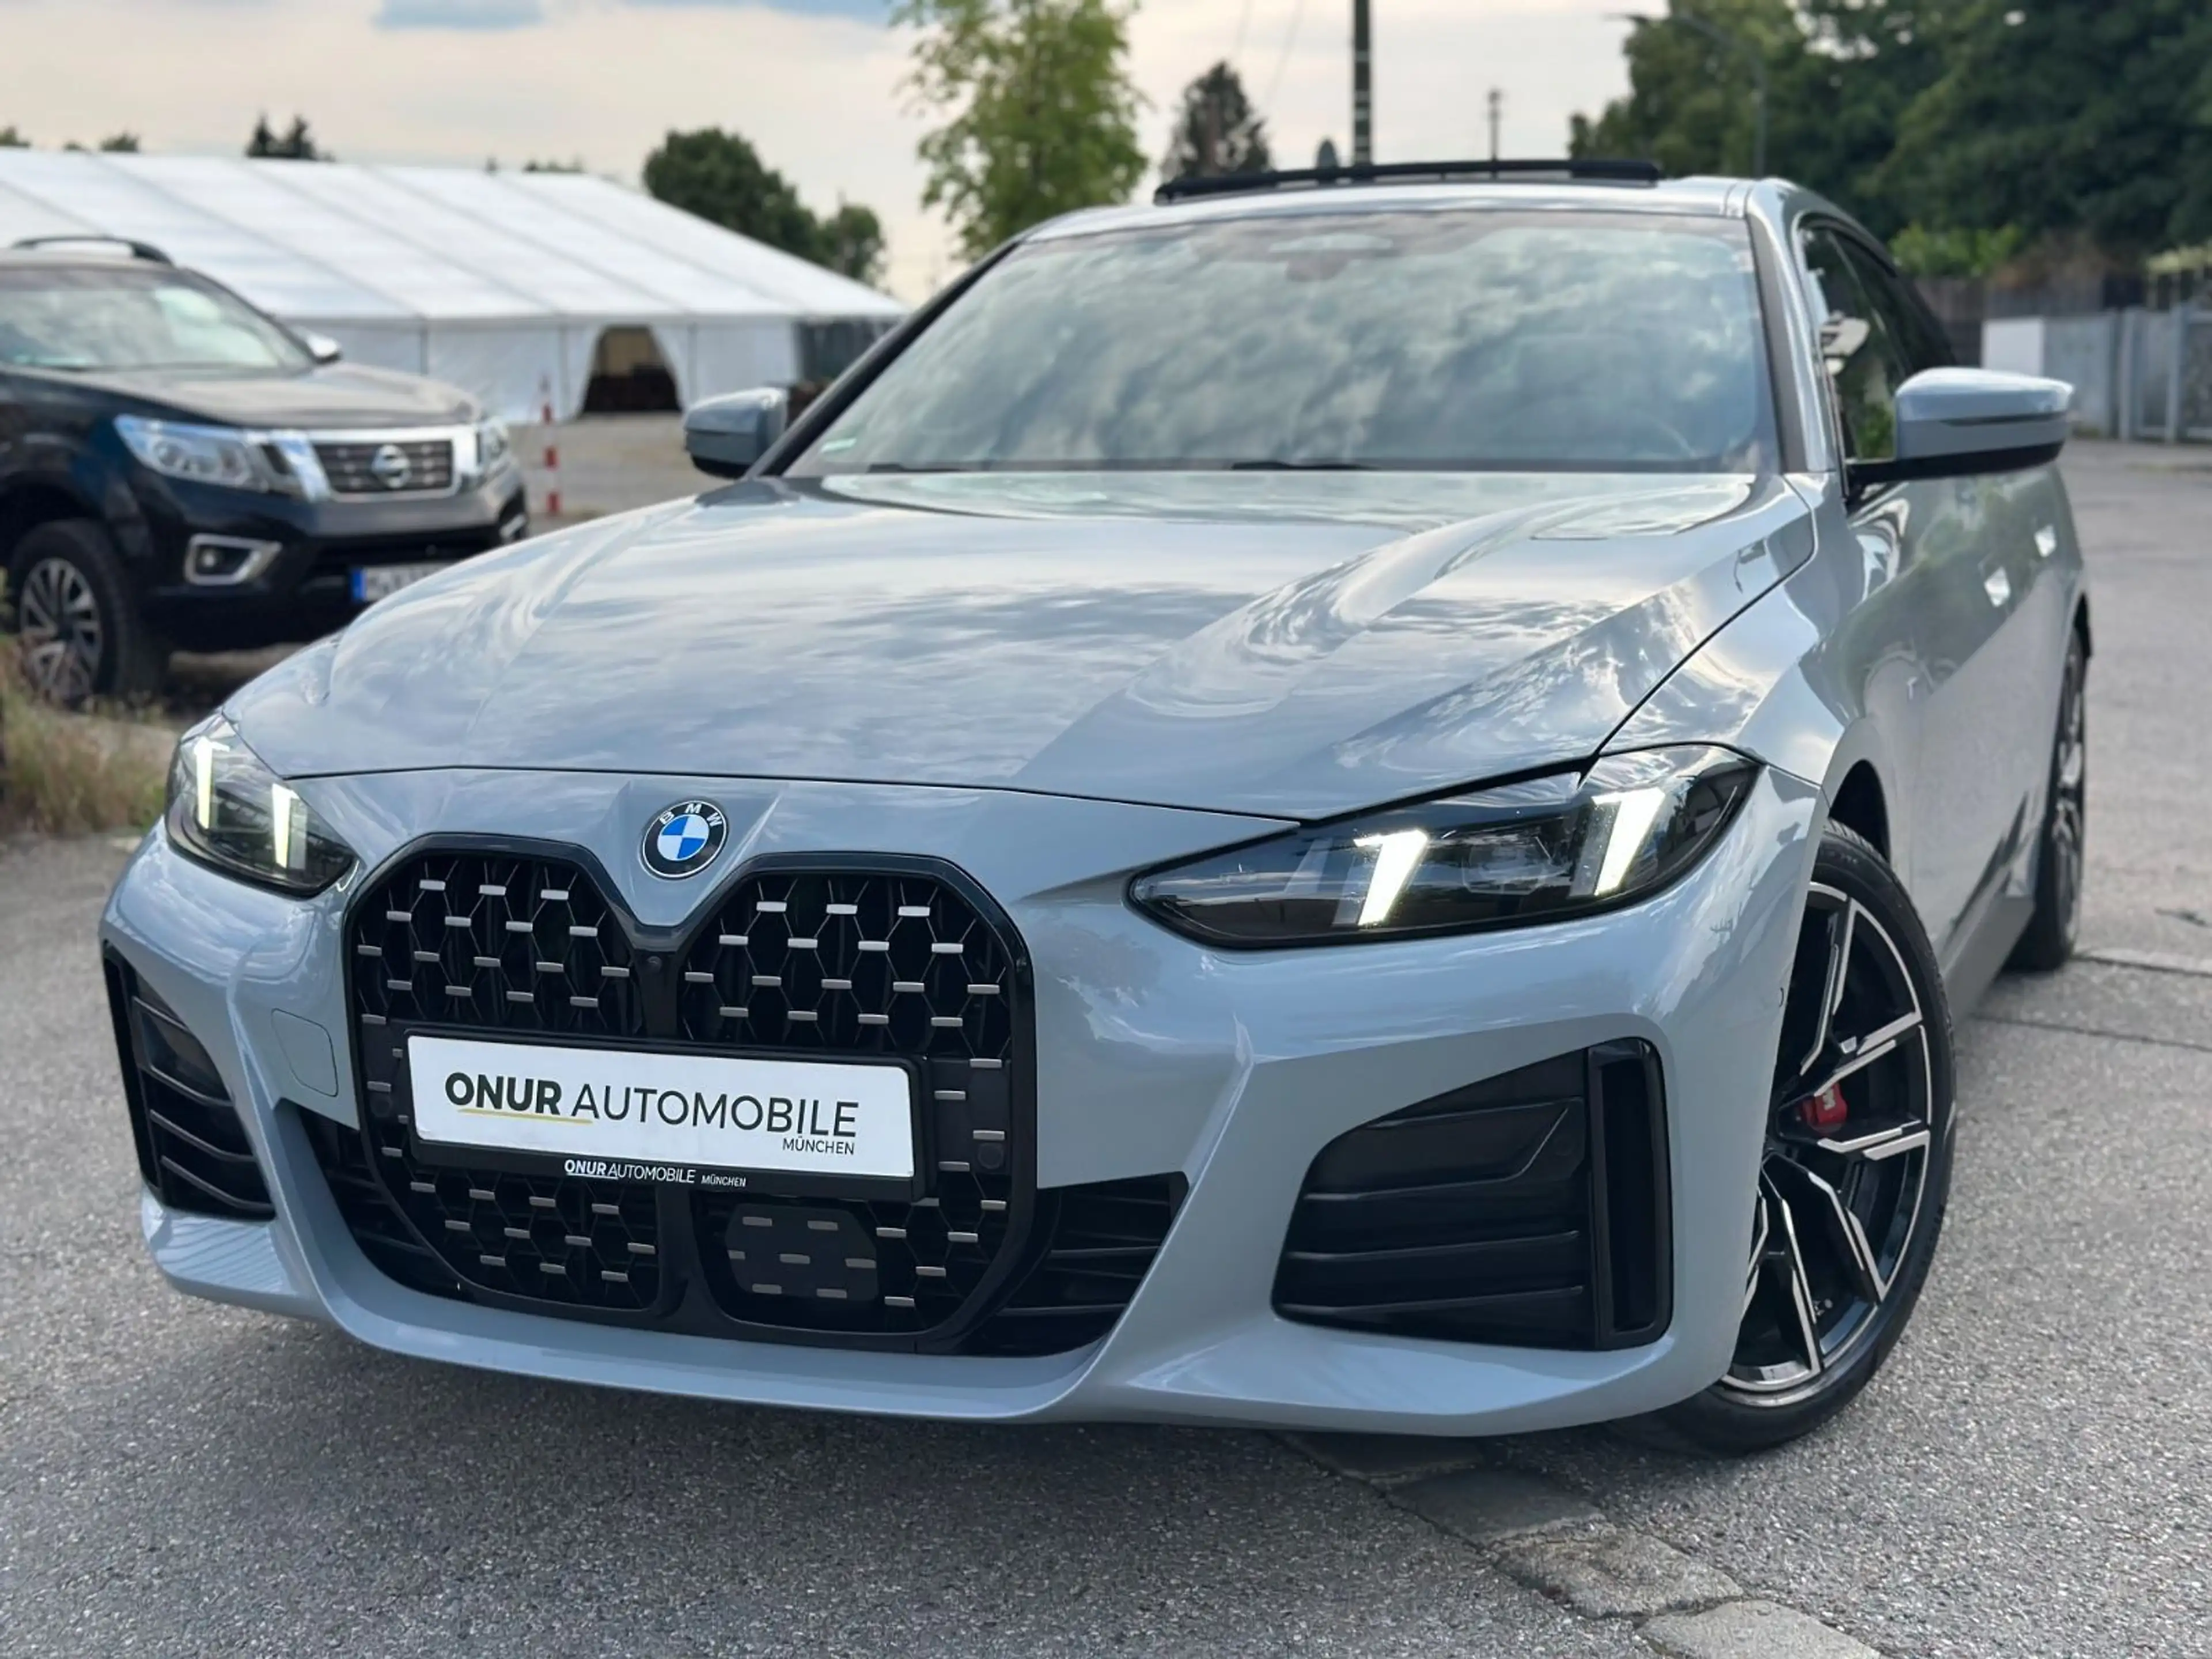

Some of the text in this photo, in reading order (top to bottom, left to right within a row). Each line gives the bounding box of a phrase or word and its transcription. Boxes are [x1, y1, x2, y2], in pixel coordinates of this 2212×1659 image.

[659, 802, 723, 828] BMW
[445, 1072, 859, 1138] ONUR AUTOMOBILE
[782, 1135, 855, 1155] MÜNCHEN
[564, 1160, 747, 1187] ONUR AUTOMOBILE MÜNCHEN
